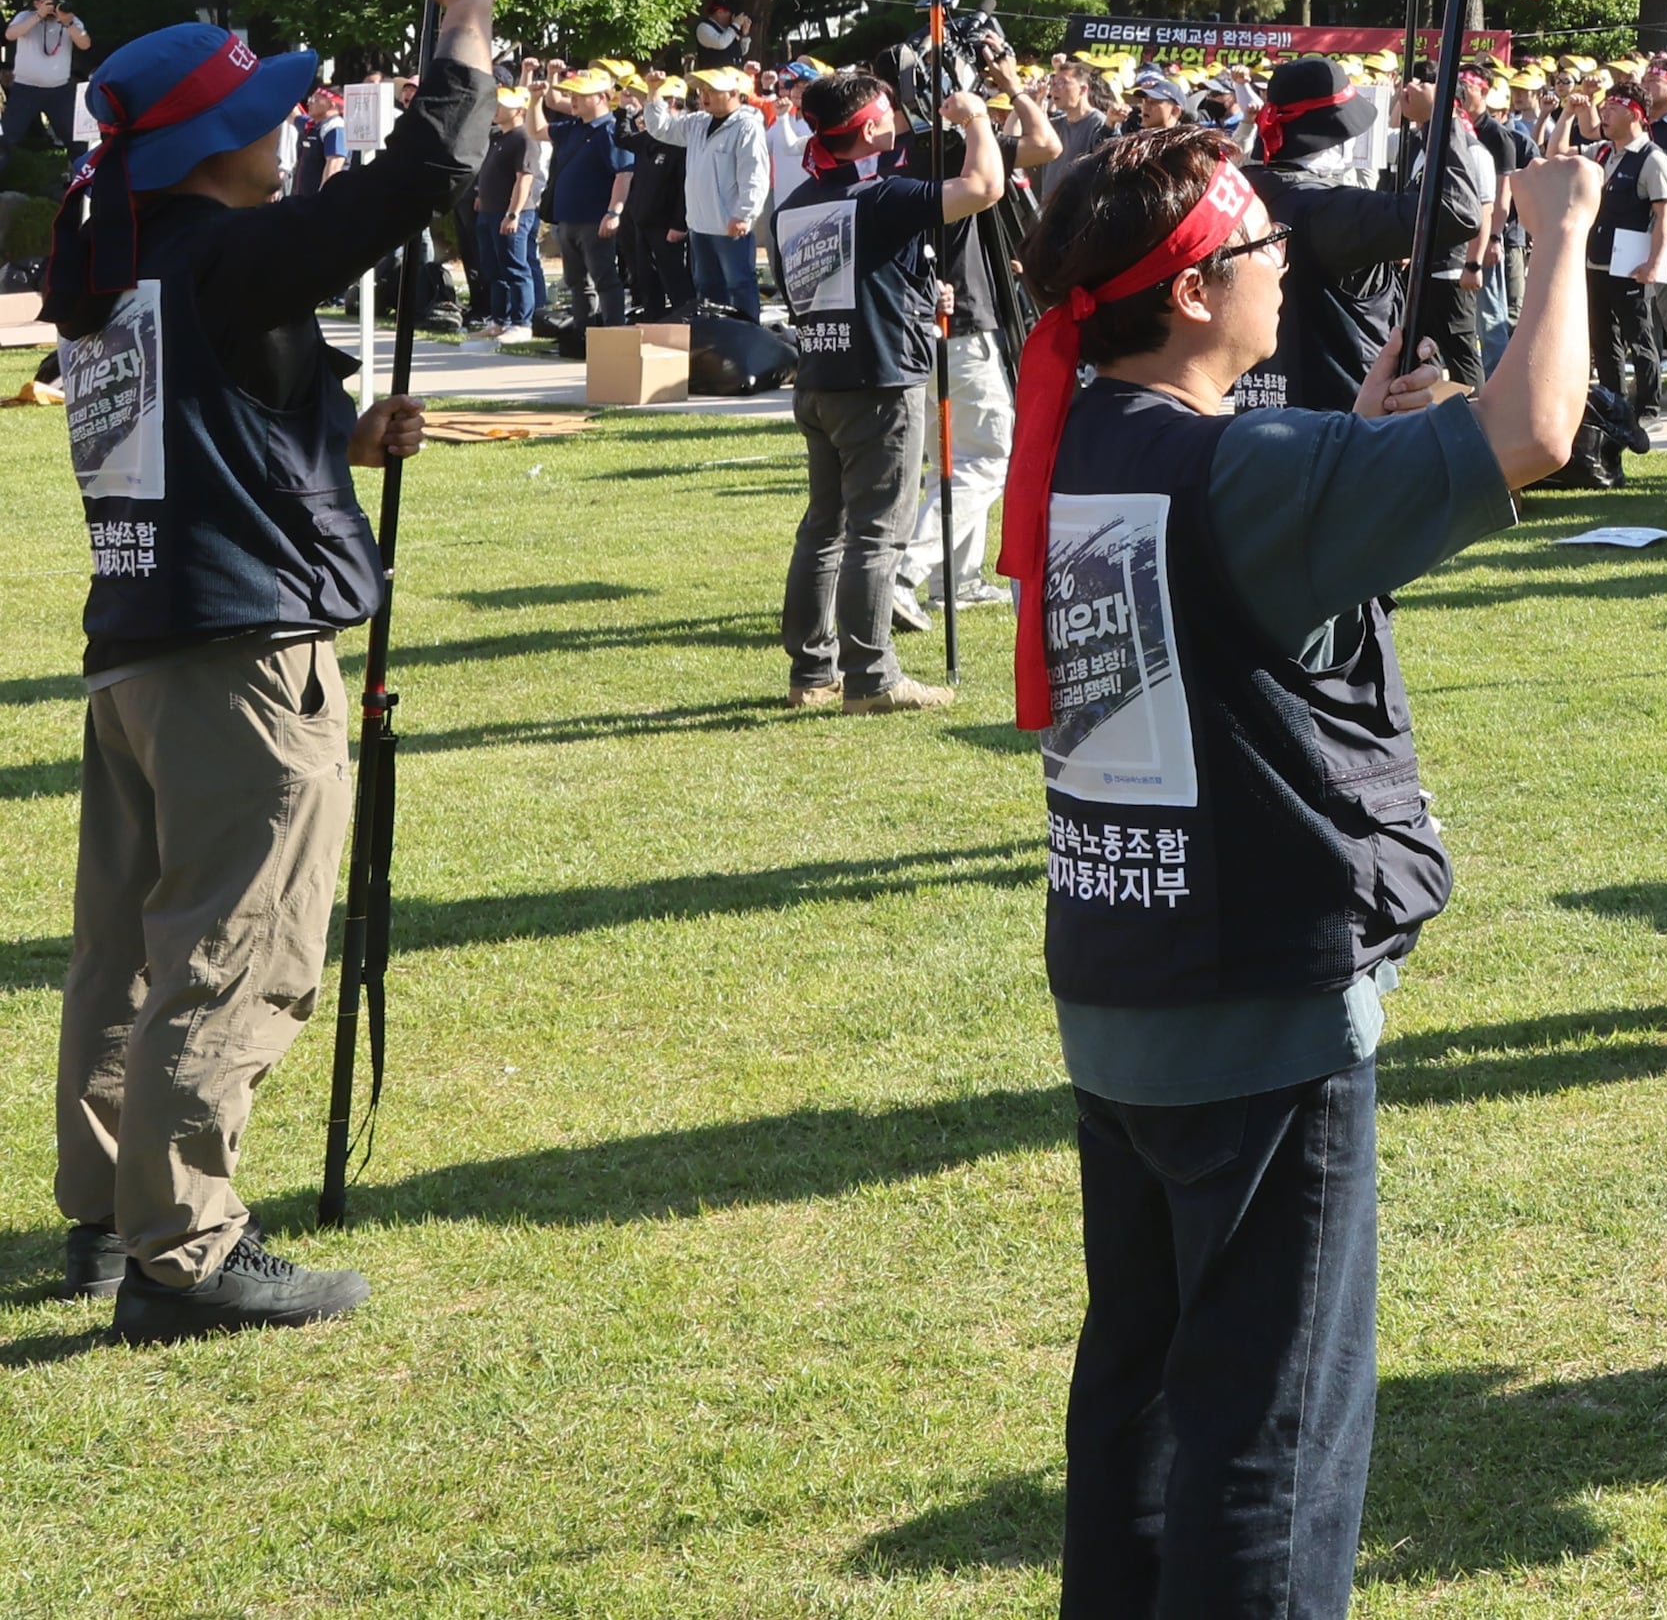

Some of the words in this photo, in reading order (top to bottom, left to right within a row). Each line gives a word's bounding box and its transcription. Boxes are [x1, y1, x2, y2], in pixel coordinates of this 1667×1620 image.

[1083, 23, 1150, 42] 2026년
[1156, 27, 1217, 45] 단체교섭
[1222, 30, 1292, 48] 완전승리!!
[1066, 660, 1089, 683] 고용
[1091, 647, 1128, 677] 보장!
[1085, 674, 1122, 705] 쟁취!
